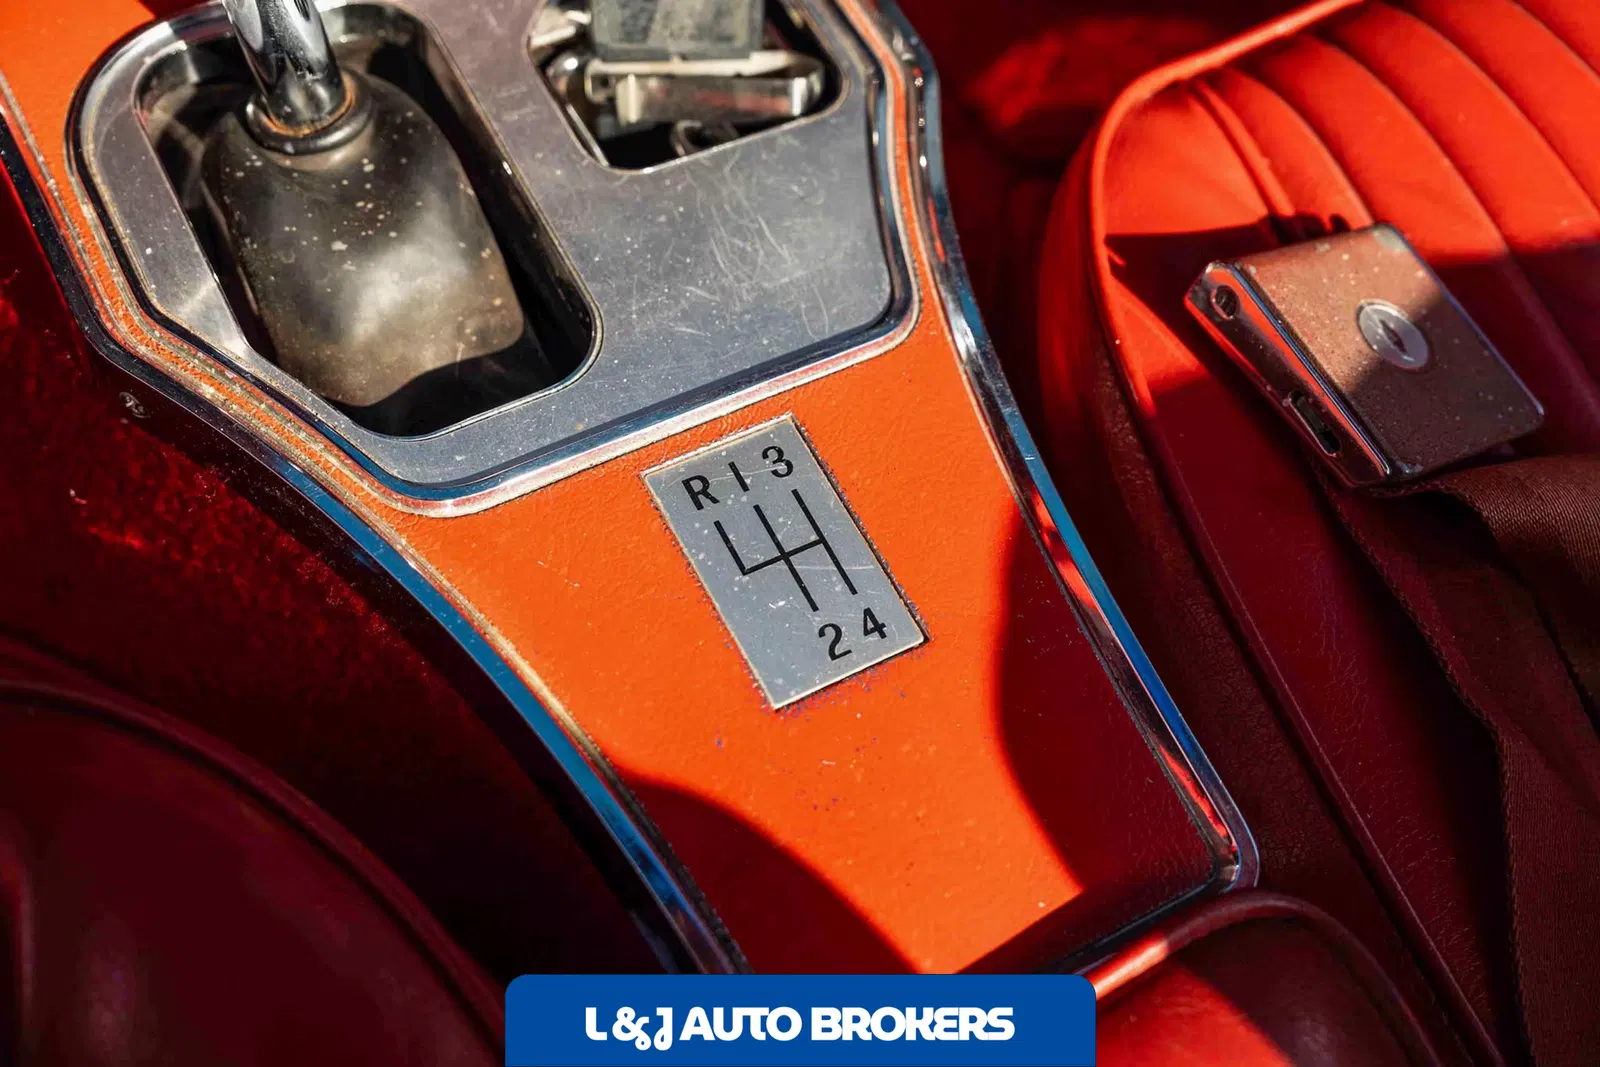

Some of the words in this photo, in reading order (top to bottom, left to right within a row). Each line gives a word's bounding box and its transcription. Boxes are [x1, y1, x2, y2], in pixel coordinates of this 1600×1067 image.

[681, 474, 720, 511] R
[761, 445, 794, 478] 3
[818, 622, 853, 662] 2
[862, 607, 887, 640] 4
